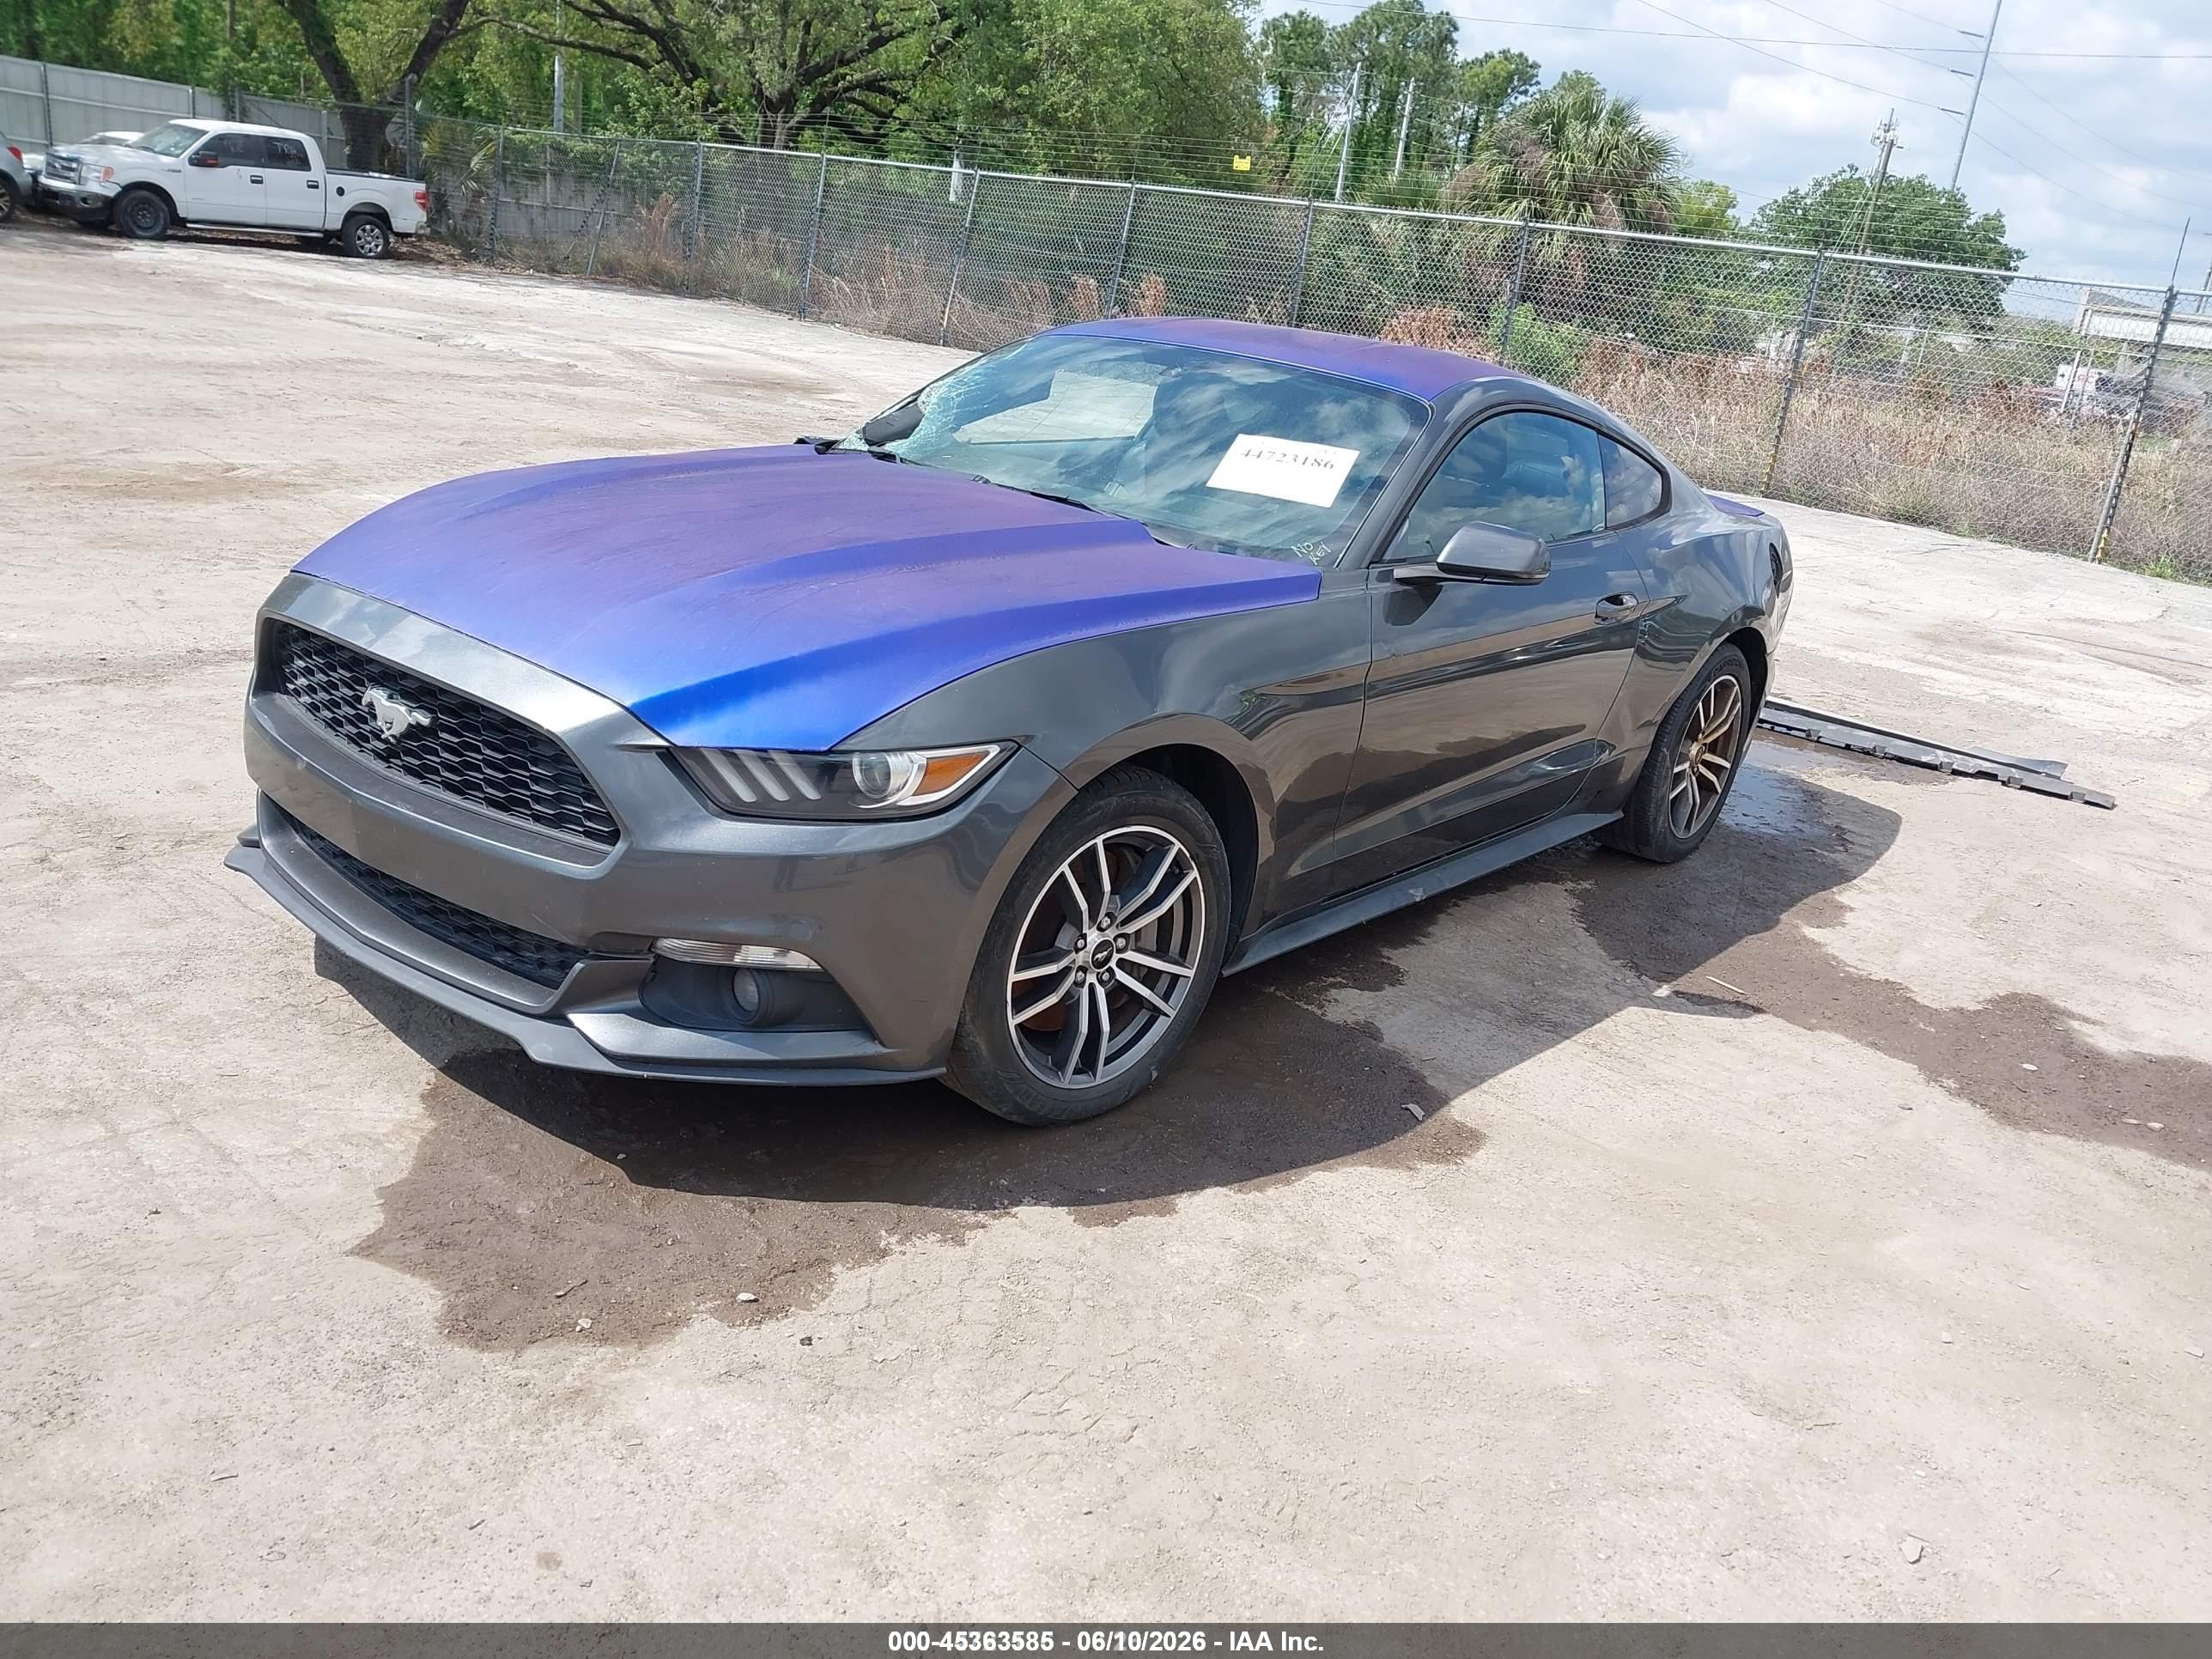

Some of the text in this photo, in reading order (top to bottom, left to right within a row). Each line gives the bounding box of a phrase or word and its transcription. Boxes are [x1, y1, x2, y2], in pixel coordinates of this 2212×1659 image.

[1240, 448, 1334, 470] 44723186
[1291, 542, 1314, 557] NO
[1309, 541, 1331, 566] KEY
